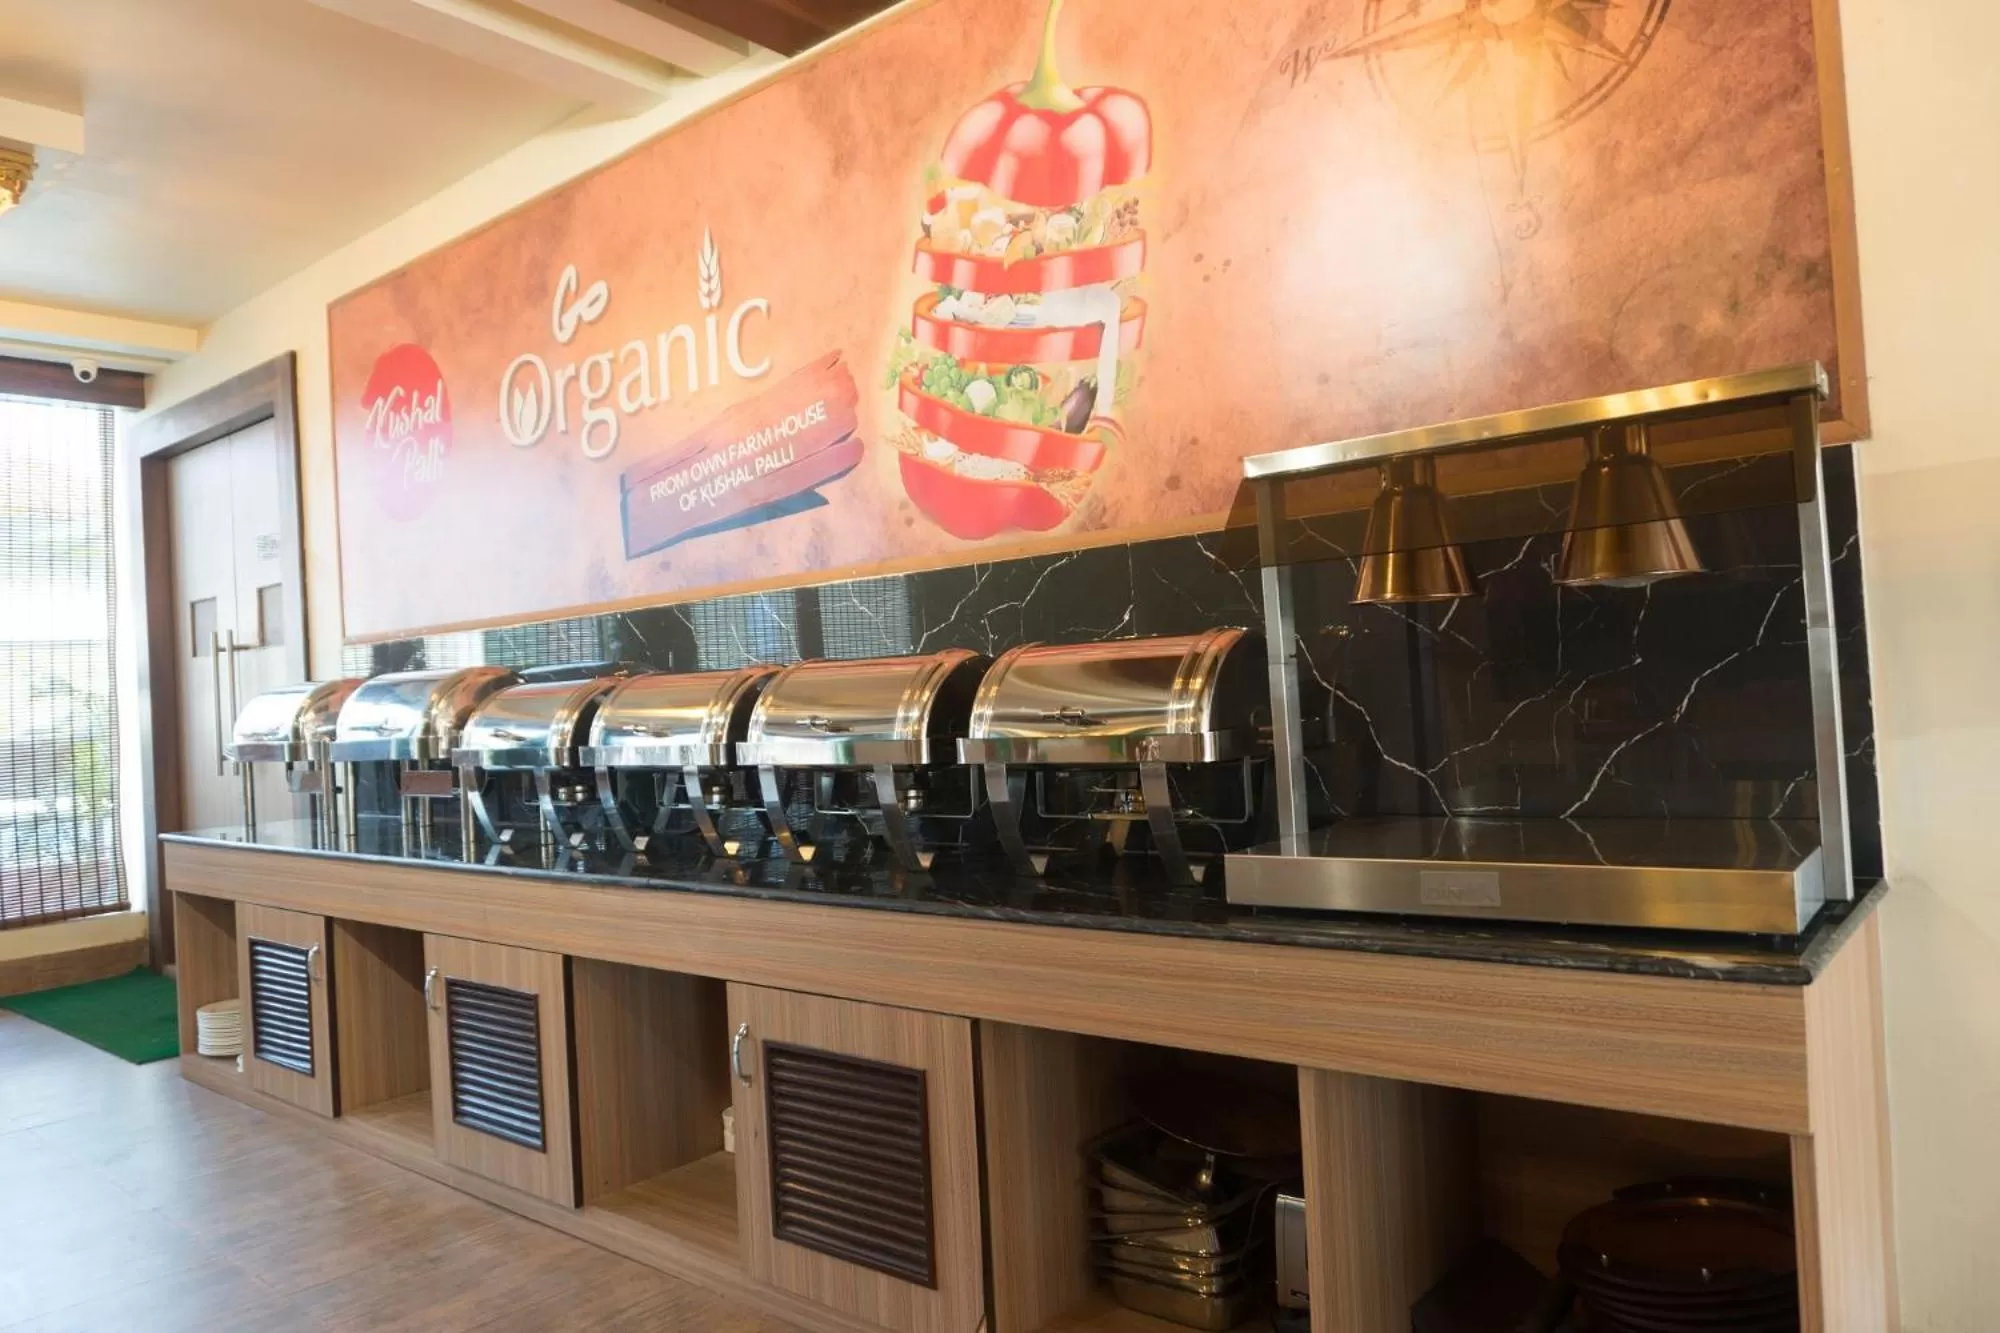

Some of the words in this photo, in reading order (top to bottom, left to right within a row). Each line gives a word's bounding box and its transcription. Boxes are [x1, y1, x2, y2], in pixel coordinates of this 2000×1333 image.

[552, 263, 610, 344] Go
[364, 377, 443, 449] Kushal
[501, 297, 772, 459] Organic
[390, 436, 445, 491] Palli
[650, 468, 689, 502] FROM
[690, 449, 729, 483] OWN
[728, 426, 774, 463] FARM
[774, 400, 828, 441] HOUSE
[678, 490, 700, 512] OF
[700, 464, 754, 507] KUSHAL
[754, 442, 795, 478] PALLI
